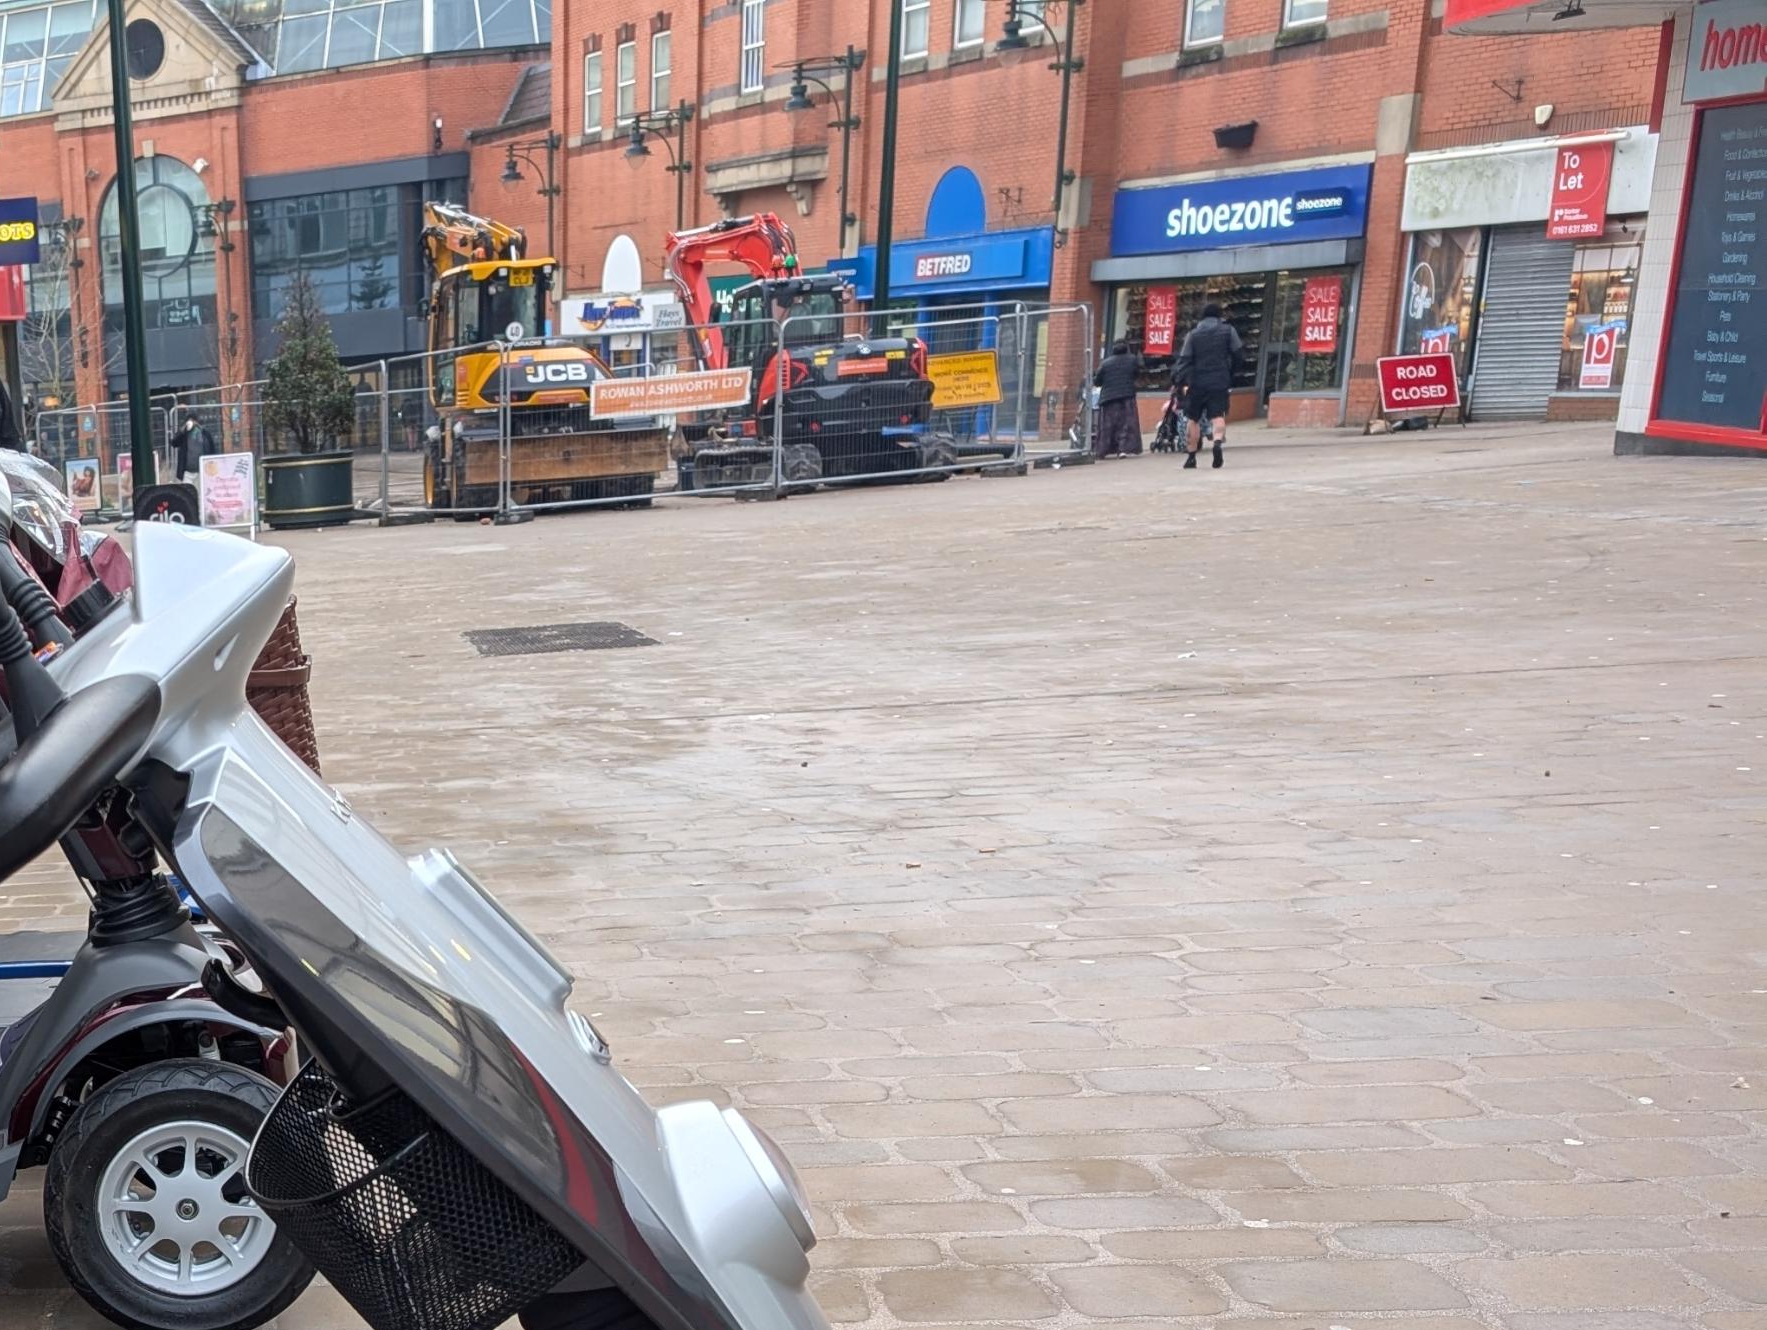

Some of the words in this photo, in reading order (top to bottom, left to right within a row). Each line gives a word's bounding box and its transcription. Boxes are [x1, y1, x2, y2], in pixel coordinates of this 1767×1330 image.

[1563, 152, 1580, 169] To
[1559, 172, 1584, 191] Let
[1296, 197, 1343, 210] shoezone
[1166, 196, 1295, 237] shoezone
[916, 254, 971, 277] BETFRED
[1150, 294, 1174, 311] SALE
[1309, 286, 1336, 304] SALE
[1149, 313, 1173, 329] SALE
[1306, 306, 1335, 324] SALE
[1149, 331, 1171, 345] SALE
[1305, 325, 1333, 342] SALE
[526, 363, 588, 383] JCB
[1396, 364, 1437, 380] ROAD
[600, 384, 645, 399] ROWAN
[648, 379, 718, 396] ASHWORTH
[721, 376, 744, 389] LTD
[1391, 385, 1448, 401] CLOSED
